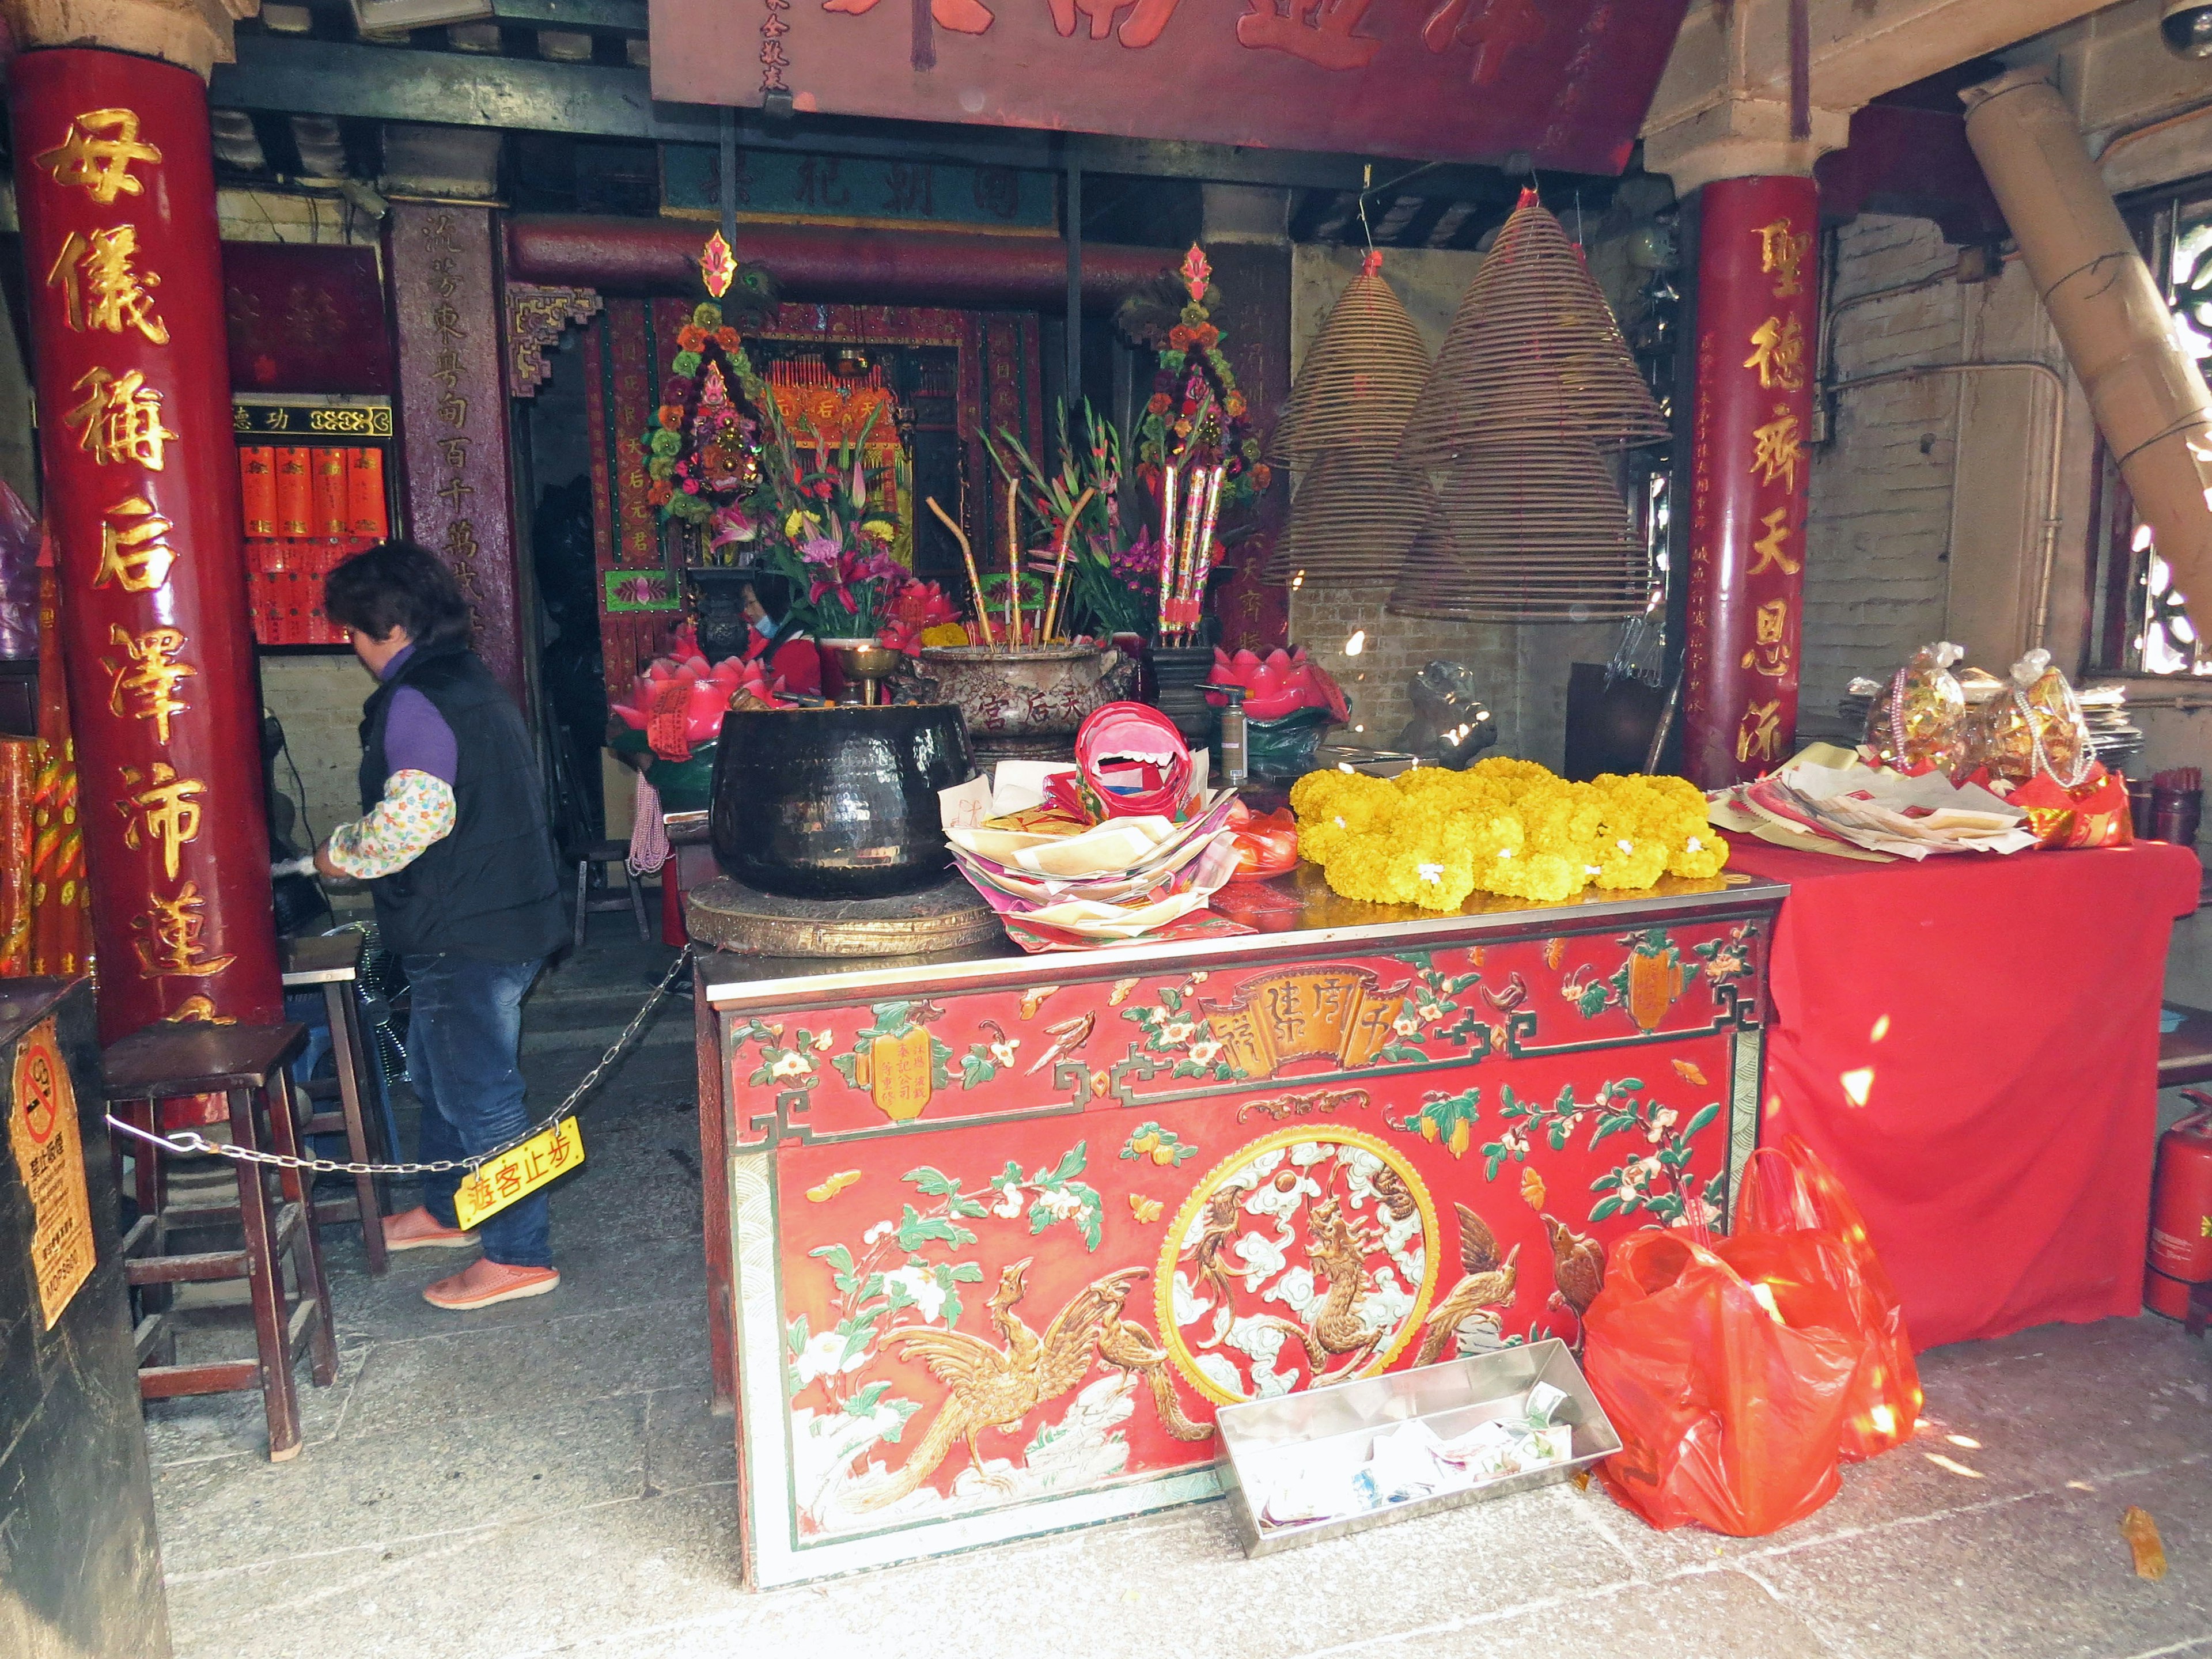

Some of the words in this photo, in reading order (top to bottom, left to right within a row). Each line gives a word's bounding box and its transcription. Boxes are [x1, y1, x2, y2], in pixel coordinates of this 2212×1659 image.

[978, 691, 1084, 729] 天后宮
[467, 1132, 571, 1216] 遊客止步
